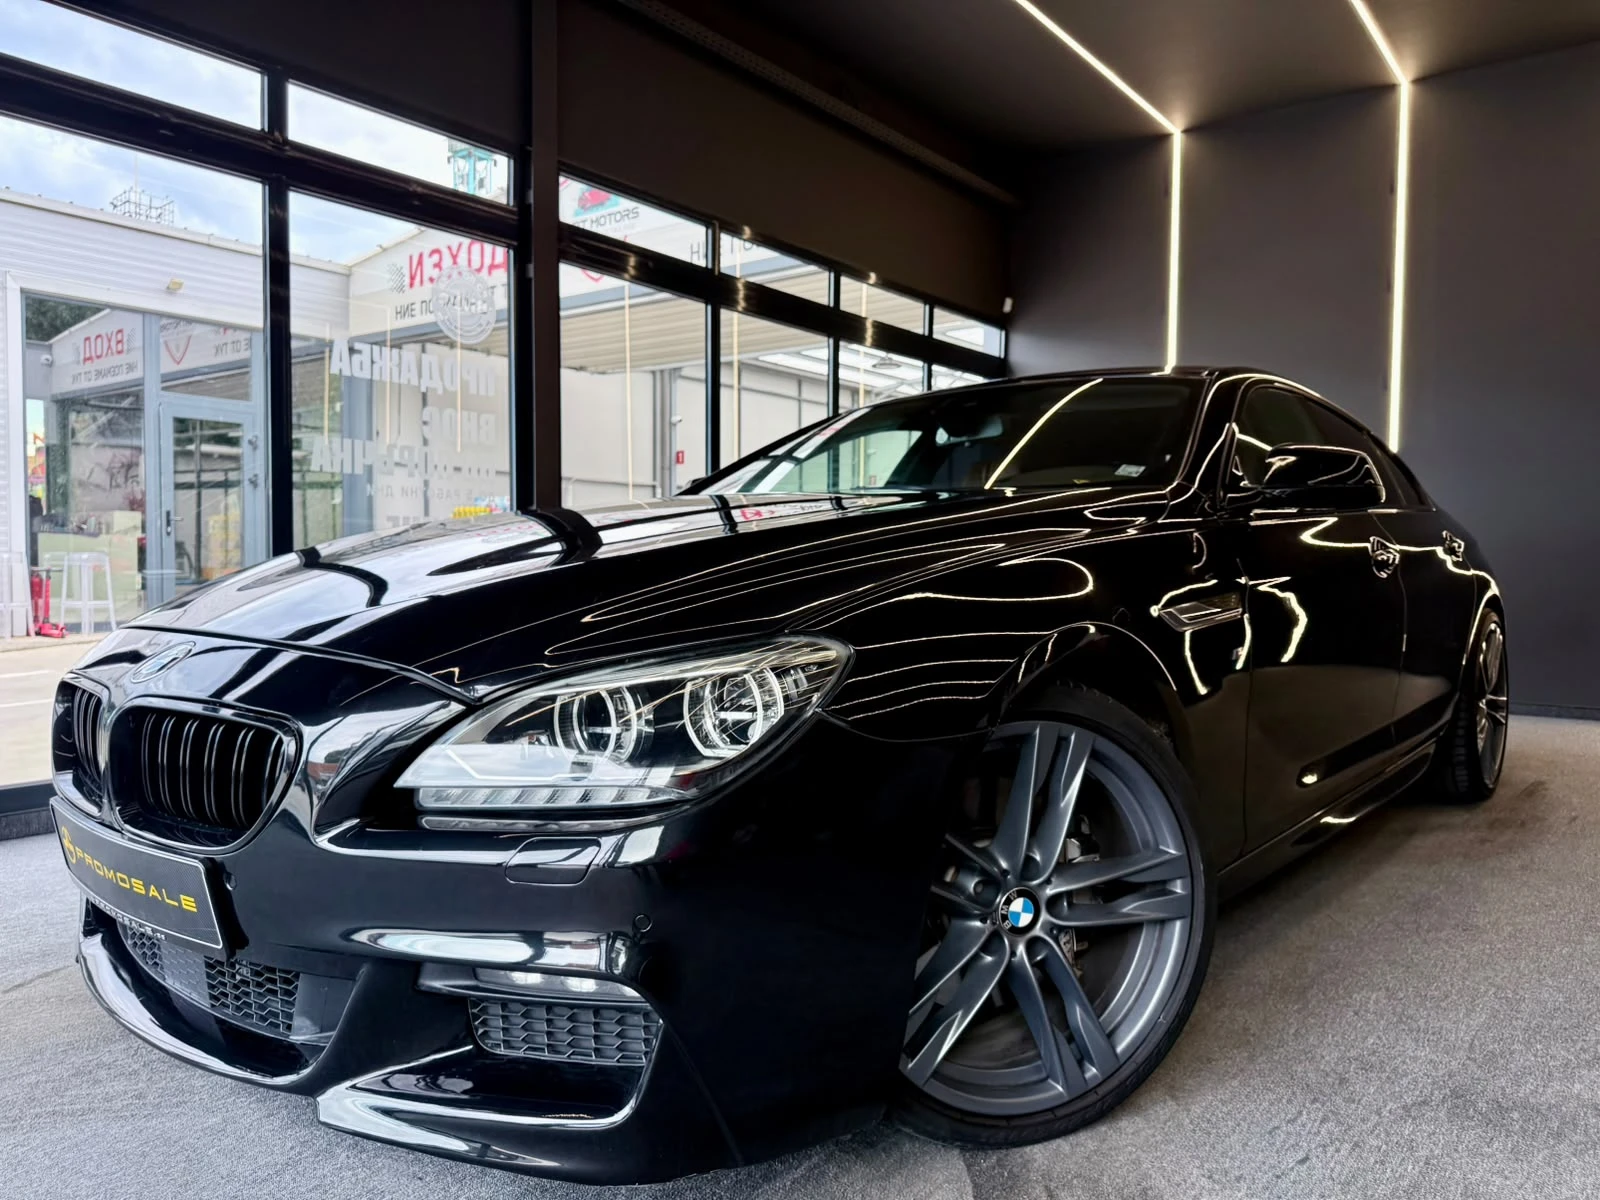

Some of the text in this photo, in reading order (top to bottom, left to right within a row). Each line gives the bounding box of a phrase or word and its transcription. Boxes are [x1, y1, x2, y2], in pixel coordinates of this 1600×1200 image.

[591, 207, 639, 228] MOTORS
[396, 302, 416, 320] НИЕ
[75, 848, 197, 912] PROMOSALE
[1000, 890, 1018, 930] BMW
